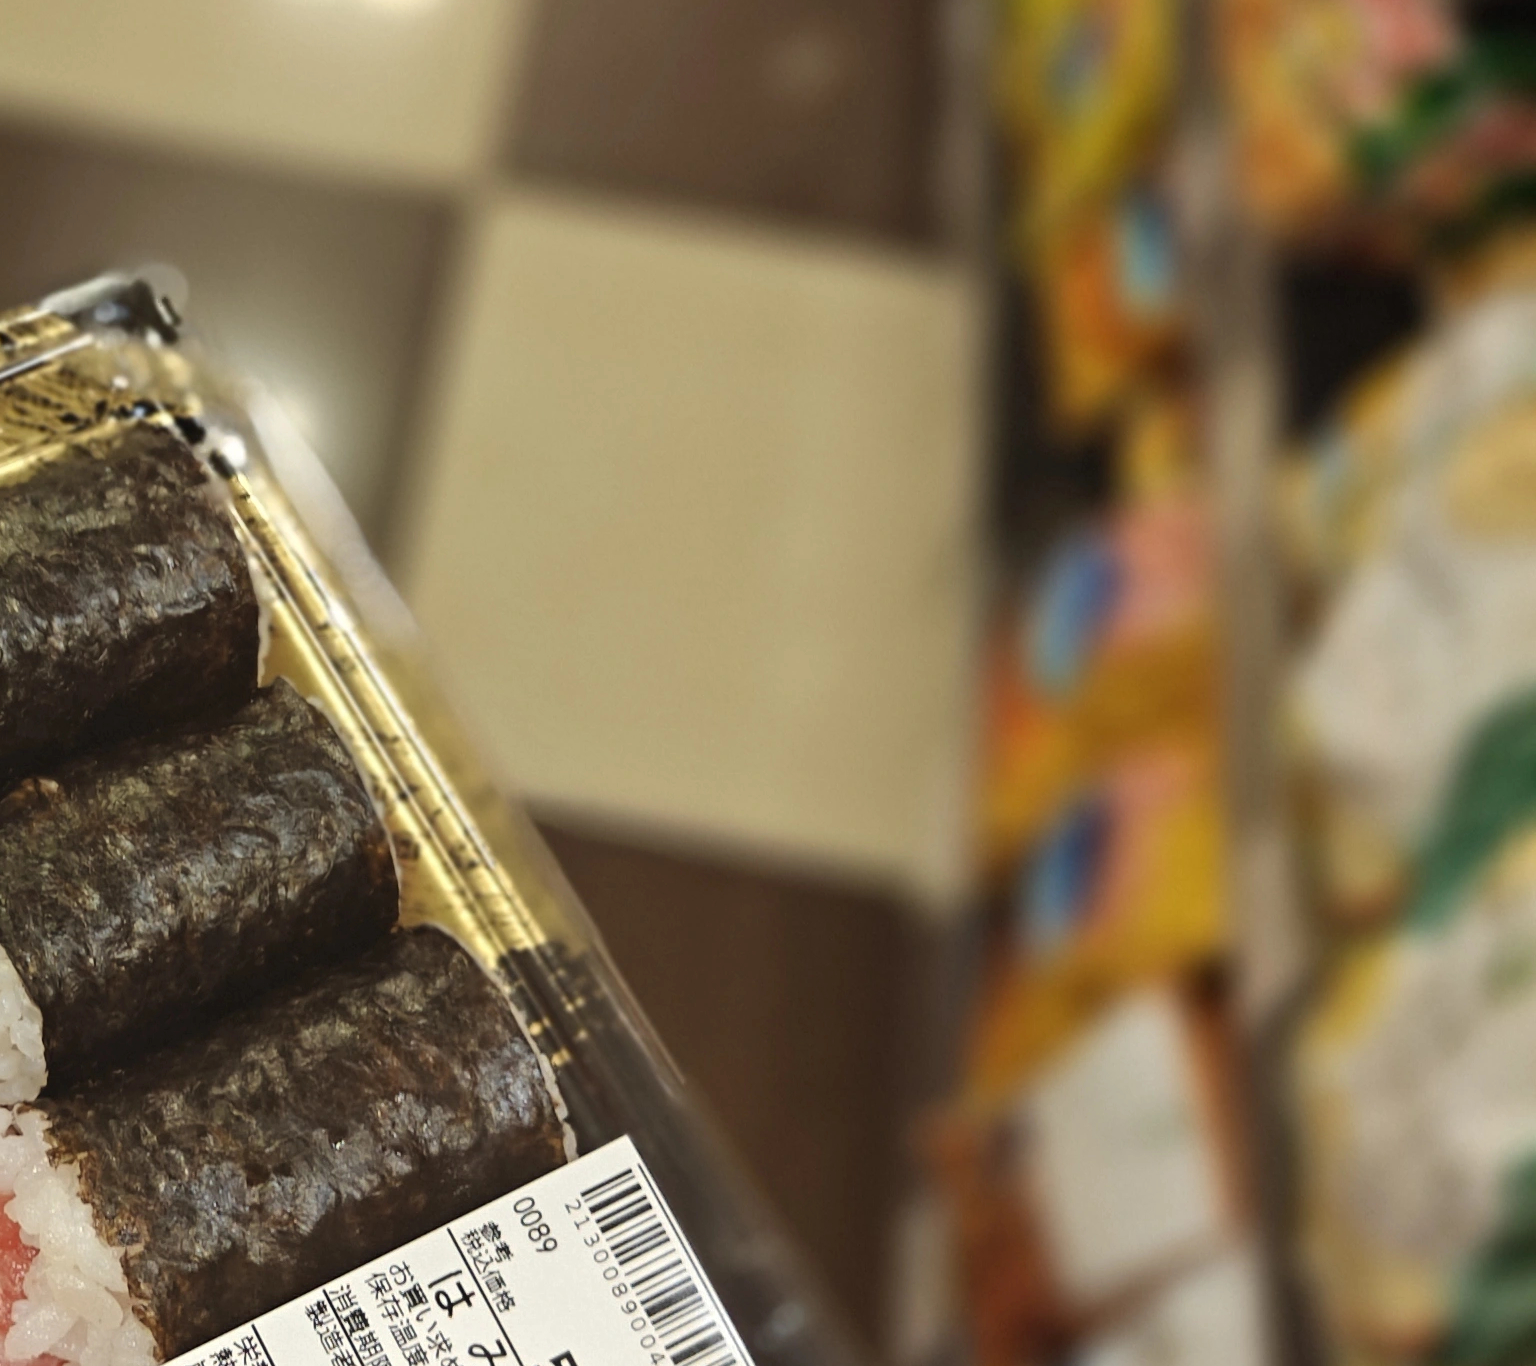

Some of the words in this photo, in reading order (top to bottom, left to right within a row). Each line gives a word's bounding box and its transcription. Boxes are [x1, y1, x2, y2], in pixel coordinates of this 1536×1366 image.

[477, 1220, 513, 1263] 参考
[512, 1196, 558, 1252] 0089
[460, 1228, 515, 1313] 税込価格
